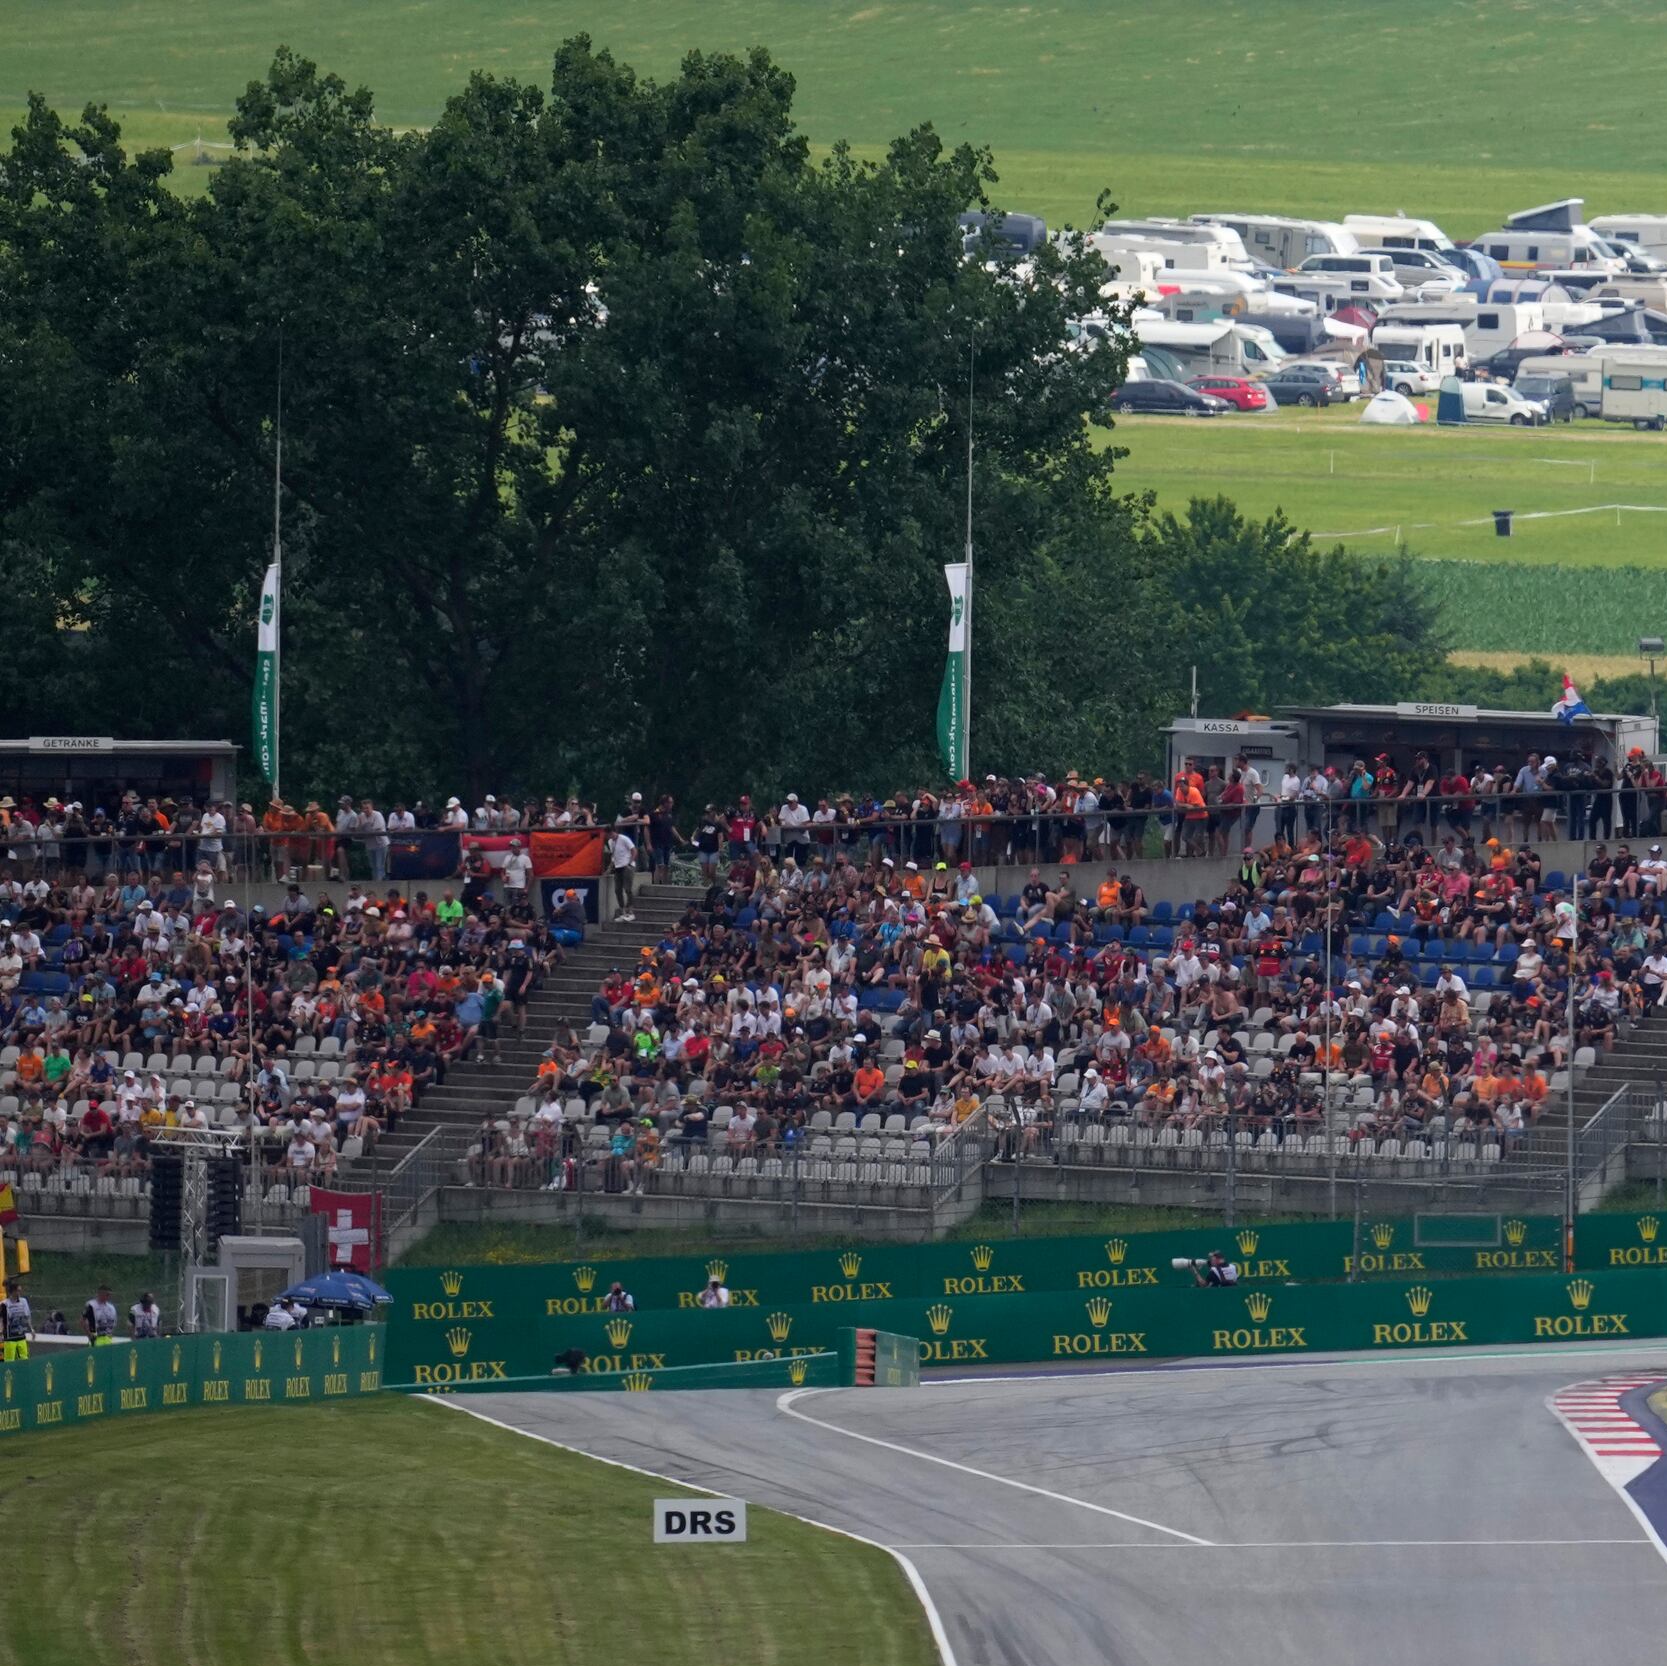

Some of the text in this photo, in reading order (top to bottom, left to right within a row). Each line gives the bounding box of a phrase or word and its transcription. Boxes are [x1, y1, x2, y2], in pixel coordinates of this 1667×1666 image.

[1415, 704, 1460, 716] SPEISEN
[1203, 722, 1240, 734] KASSA
[1233, 1259, 1291, 1278] OLEX
[1476, 1249, 1558, 1269] ROLEX
[944, 1275, 1024, 1295] ROLEX
[1078, 1267, 1159, 1288] ROLEX
[812, 1282, 893, 1303] ROLEX
[413, 1301, 494, 1320] ROLEX
[546, 1298, 611, 1316] ROLE
[1373, 1321, 1468, 1343] ROLEX
[1534, 1314, 1629, 1337] ROLEX
[1052, 1332, 1147, 1355] ROLEX
[1213, 1327, 1307, 1349] ROLEX
[919, 1338, 988, 1361] OLEX
[414, 1360, 508, 1384] ROLEX
[162, 1382, 188, 1405] ROLEX
[203, 1380, 229, 1401] ROLEX
[245, 1378, 271, 1400] ROLEX
[286, 1376, 310, 1399] ROLEX
[324, 1374, 348, 1395] ROLEX
[78, 1393, 104, 1417] ROLEX
[120, 1387, 147, 1409] ROLEX
[37, 1401, 63, 1424] ROLEX
[664, 1511, 736, 1535] DRS
